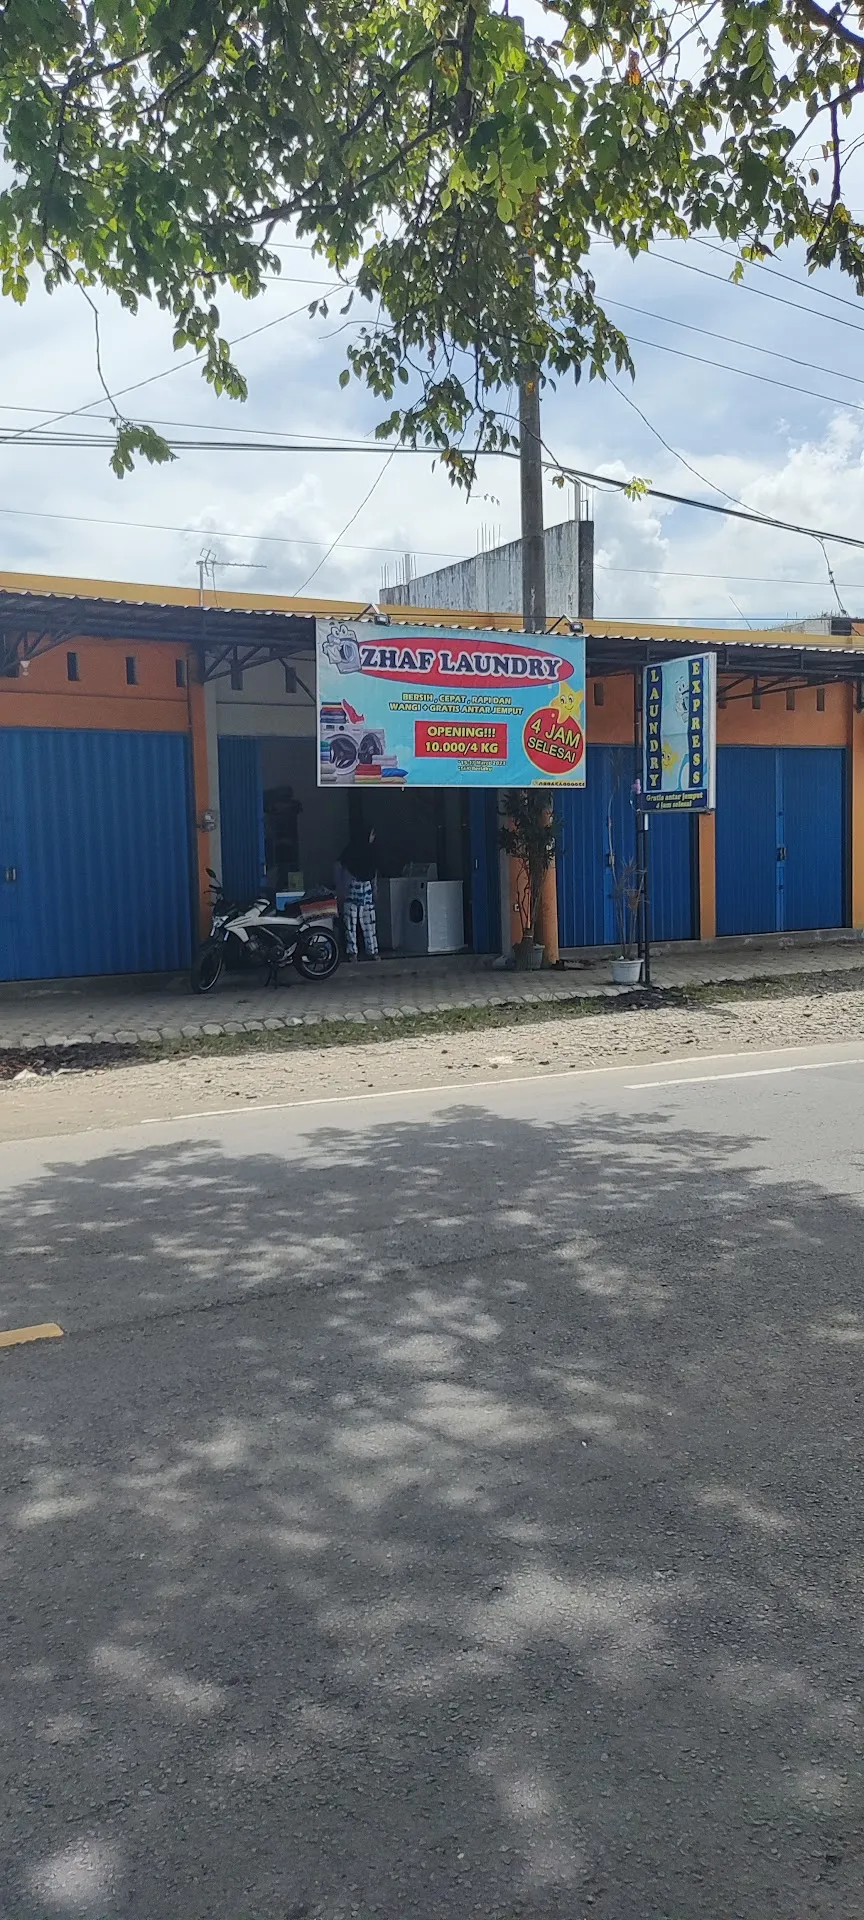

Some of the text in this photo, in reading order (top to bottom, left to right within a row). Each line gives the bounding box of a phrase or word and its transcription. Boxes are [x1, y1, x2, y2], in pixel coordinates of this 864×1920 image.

[361, 647, 563, 679] ZHAF LAUNDRY
[389, 702, 421, 711] WANGI
[429, 703, 460, 713] GRATIS
[461, 705, 491, 714] ANTAR
[492, 706, 524, 716] JEMPUT
[402, 692, 433, 702] BERSIH
[439, 694, 467, 704] CEPAT
[471, 696, 493, 704] RAPI
[493, 697, 512, 705] DAN
[427, 726, 496, 738] OPENING!!!
[530, 718, 581, 748] 4 JAM
[648, 669, 659, 787] LAUNDRY
[691, 662, 701, 784] EXPRESS
[425, 741, 499, 756] 10.000/4 KG
[527, 736, 577, 764] SELESAI
